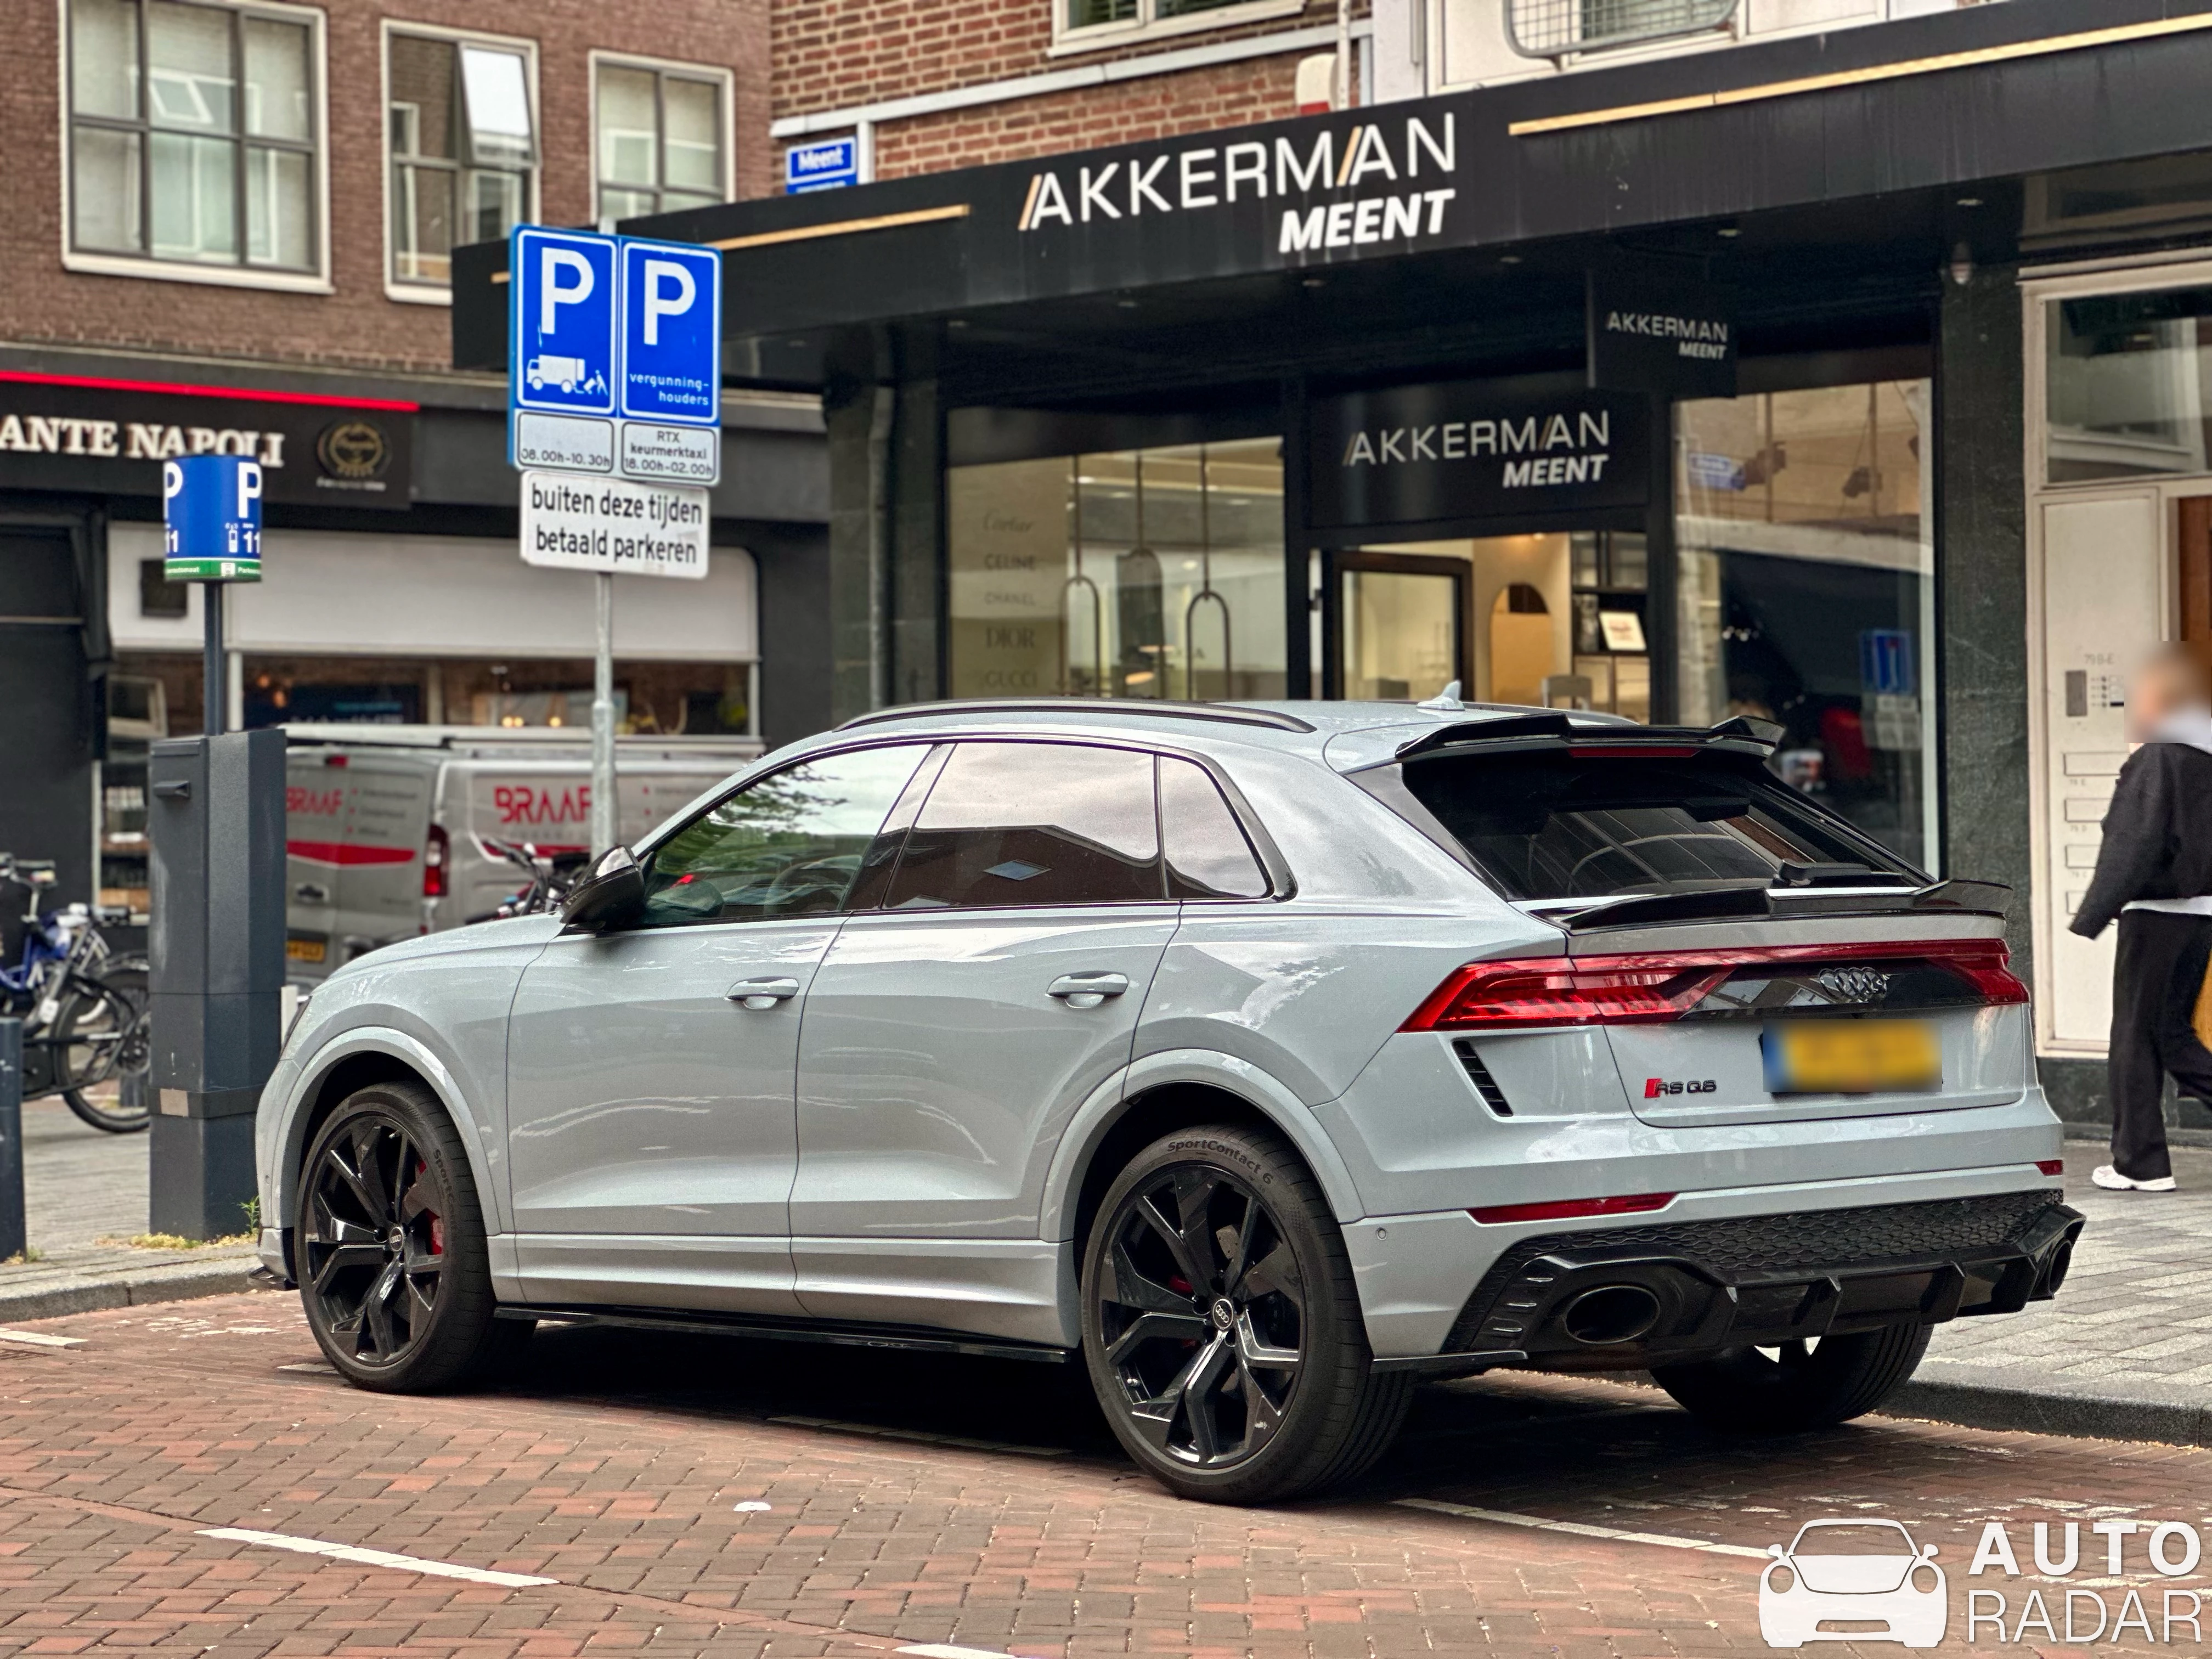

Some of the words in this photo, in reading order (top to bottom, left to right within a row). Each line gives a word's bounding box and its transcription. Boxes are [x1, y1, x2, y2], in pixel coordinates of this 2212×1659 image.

[1018, 112, 1455, 231] AKKERMAN
[1278, 188, 1455, 253] MEENT
[541, 247, 594, 334] P
[644, 259, 696, 345] P
[1607, 311, 1728, 343] AKKERMAN
[1678, 341, 1727, 360] MEENT
[629, 373, 709, 392] vergunning-
[658, 390, 709, 405] houders
[0, 414, 119, 457] ANTE
[125, 424, 285, 467] NAPOLI
[630, 443, 707, 459] keurmerktaxi
[657, 431, 680, 443] RTX
[1342, 410, 1609, 467] AKKERMAN
[1503, 454, 1609, 488] MEENT
[238, 462, 262, 518] P
[532, 483, 595, 515] buiten
[600, 491, 644, 518] deze
[648, 494, 702, 528] tijden
[536, 524, 608, 556] betaald
[613, 531, 697, 563] parkeren
[985, 553, 1035, 571] CELINE
[986, 628, 1035, 649] DIOR
[985, 670, 1038, 688] GUCCI
[286, 786, 342, 816] BRAAF
[494, 787, 591, 824] BRAAF
[1651, 1080, 1684, 1096] RS
[1686, 1080, 1717, 1093] Q8
[1167, 1139, 1261, 1175] SportContact
[1262, 1172, 1274, 1186] 6
